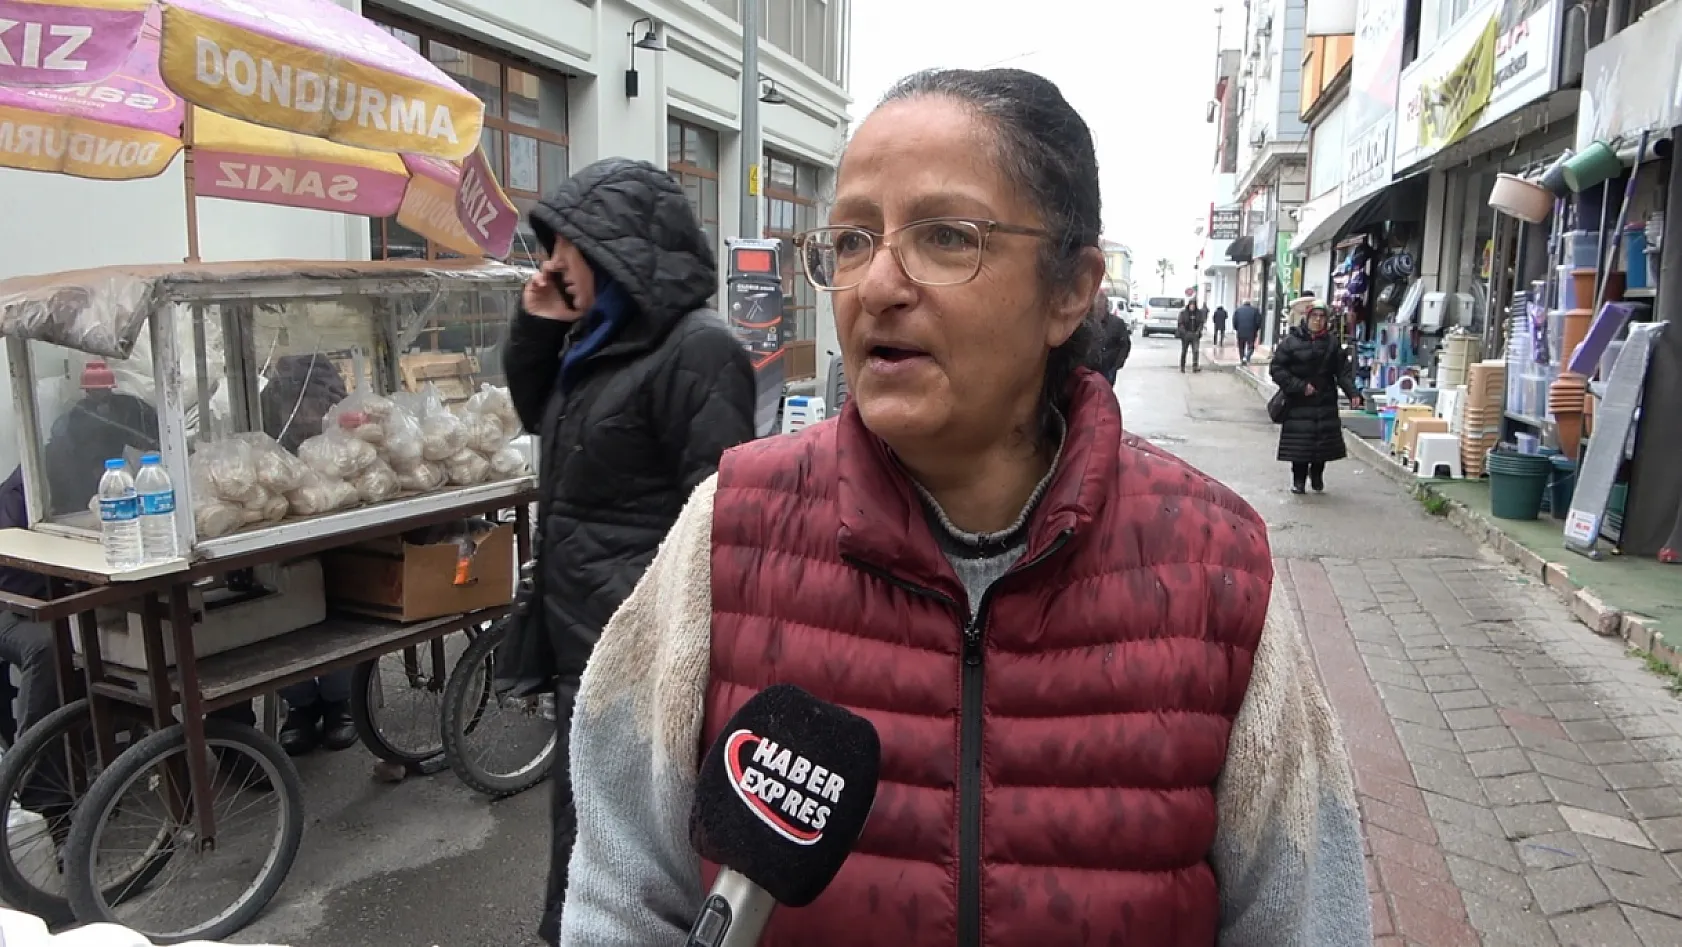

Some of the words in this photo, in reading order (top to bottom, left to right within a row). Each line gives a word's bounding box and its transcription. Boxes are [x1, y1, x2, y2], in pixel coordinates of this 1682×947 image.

[196, 36, 459, 145] DONDURMA
[740, 766, 831, 831] EXPRES
[752, 737, 845, 803] HABER
